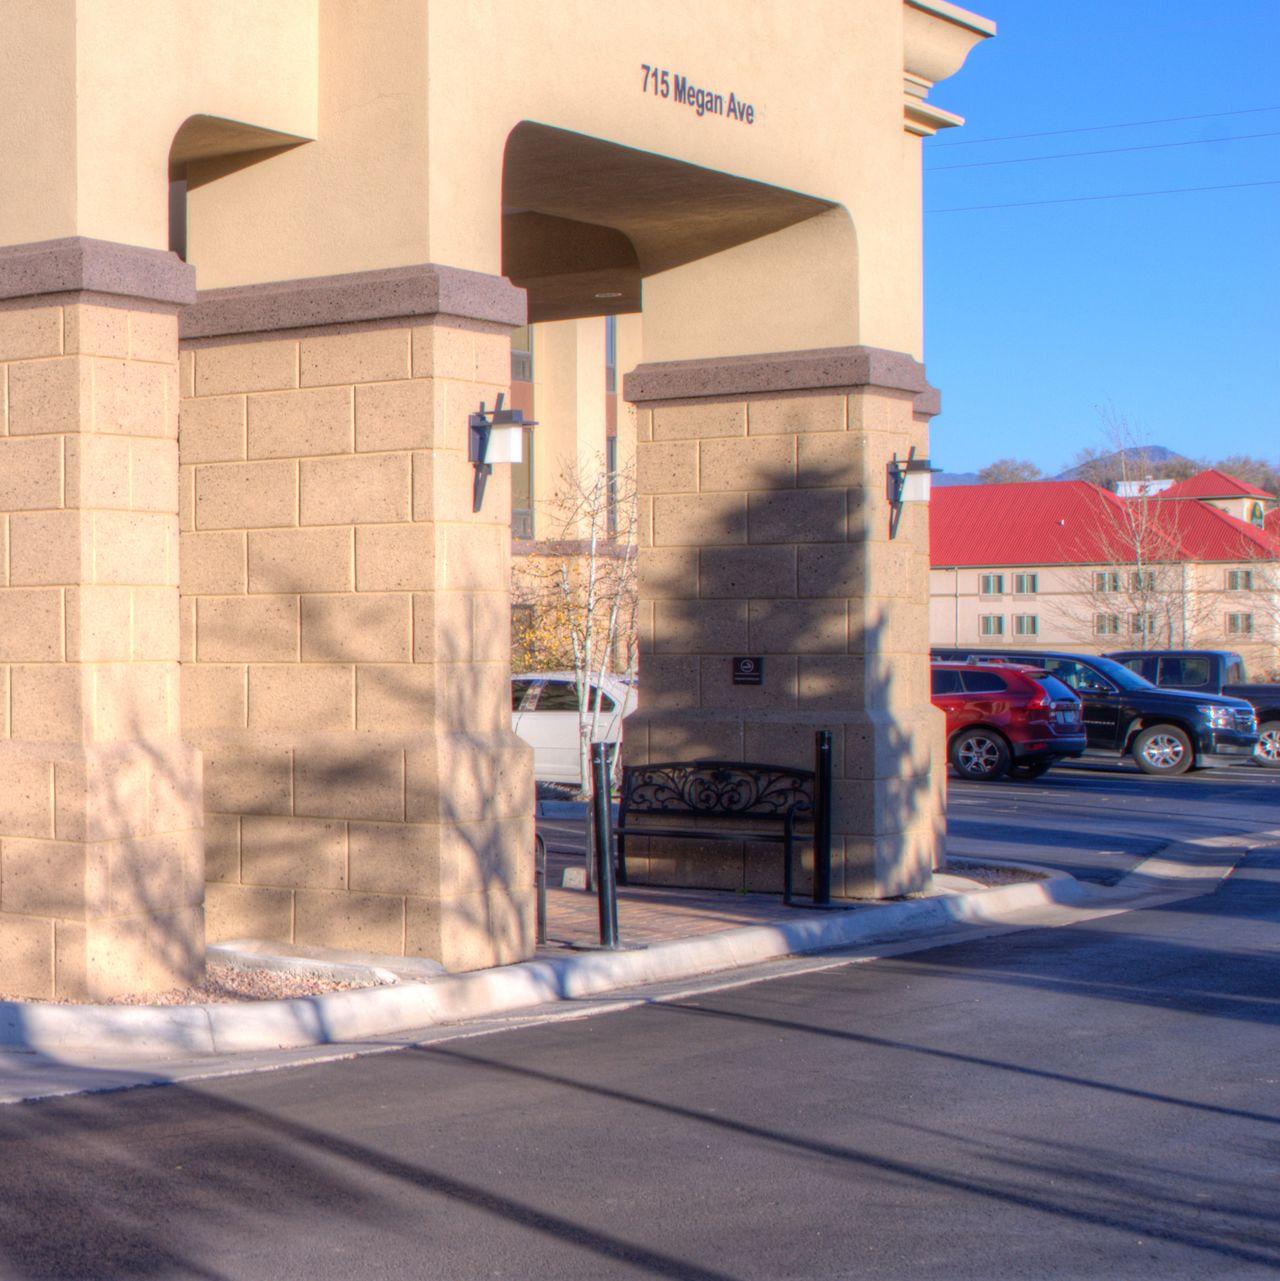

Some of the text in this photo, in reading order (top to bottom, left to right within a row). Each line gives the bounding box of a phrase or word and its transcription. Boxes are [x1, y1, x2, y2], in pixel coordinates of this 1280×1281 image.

[641, 64, 755, 125] 715 Megan Ave
